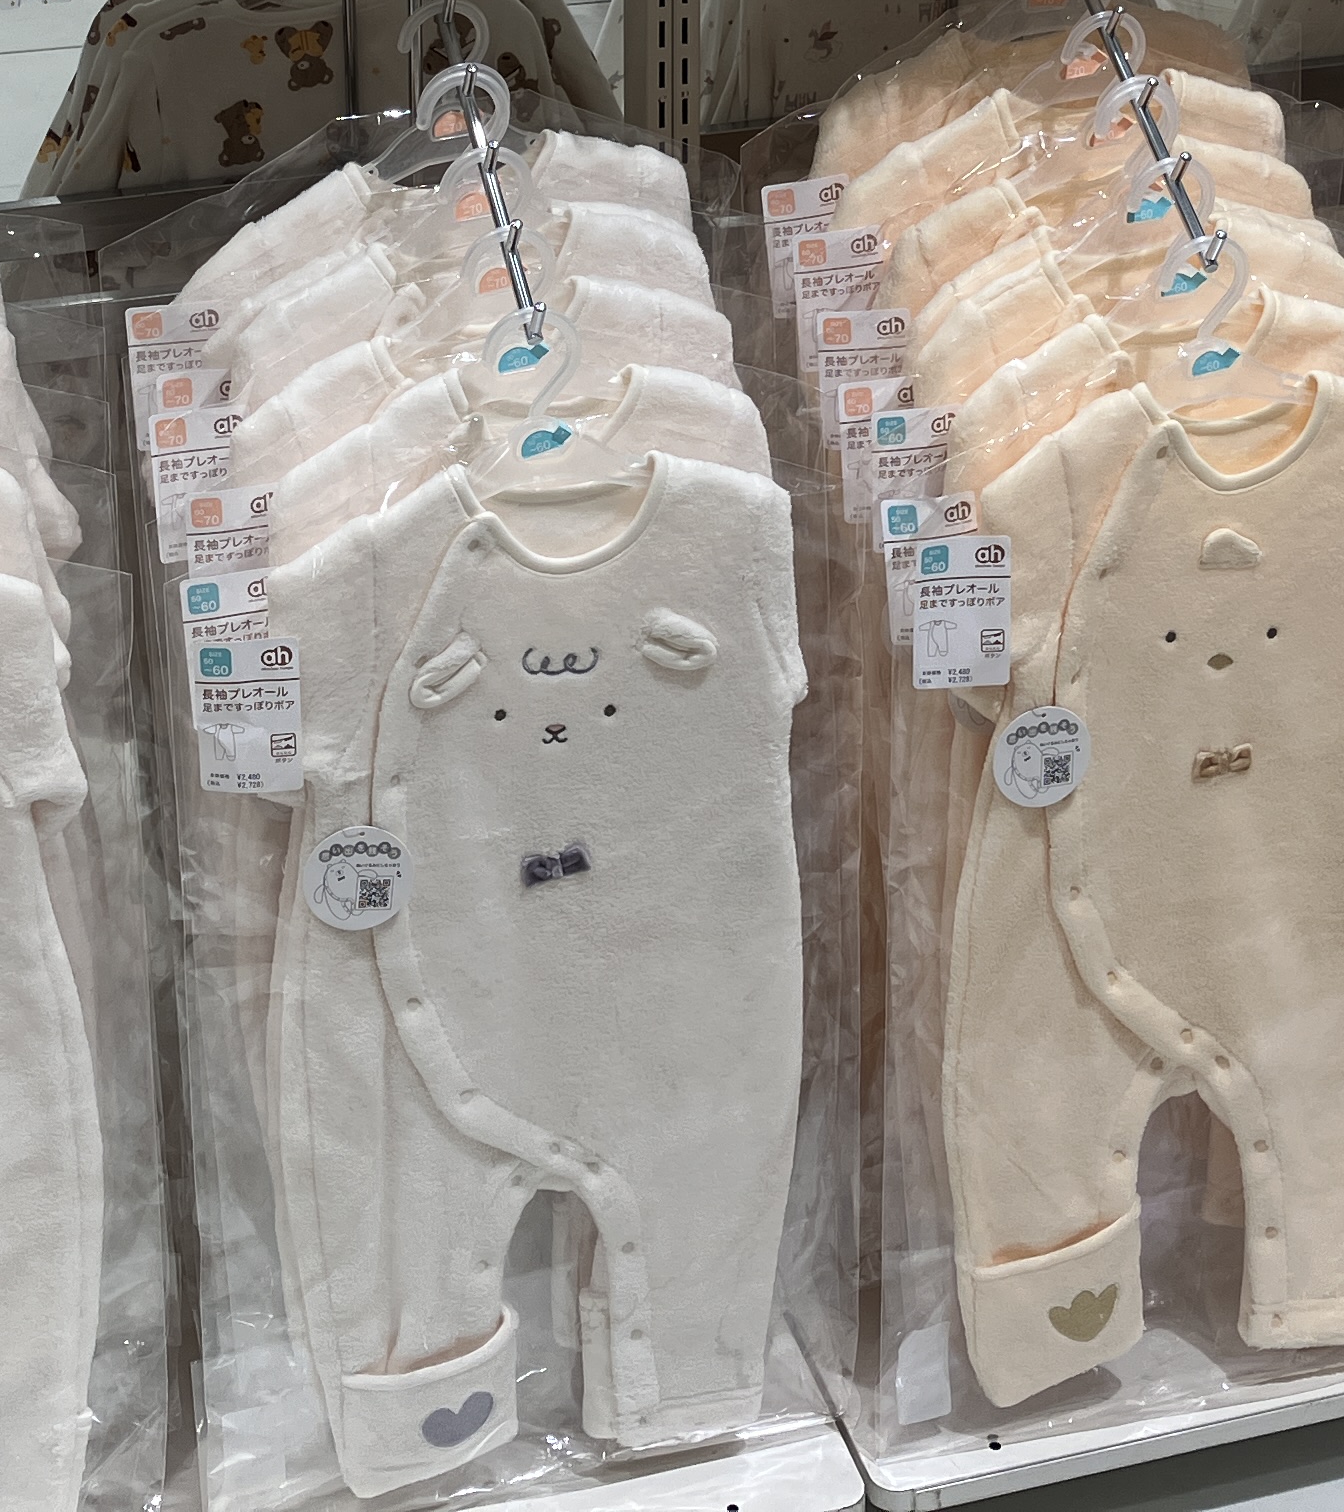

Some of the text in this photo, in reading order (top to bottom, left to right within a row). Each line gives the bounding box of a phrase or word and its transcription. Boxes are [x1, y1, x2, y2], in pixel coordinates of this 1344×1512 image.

[819, 182, 845, 203] ah
[850, 233, 878, 254] ah
[801, 270, 875, 288] 長袖プレオール
[189, 309, 220, 328] ah
[876, 316, 905, 336] ah
[824, 353, 901, 367] 長袖プレオール
[944, 500, 972, 522] ah
[974, 544, 1006, 564] ah
[919, 583, 1000, 598] 長袖プレオール
[919, 596, 1006, 610] 足まですっぽりボア
[260, 645, 293, 667] ah
[202, 686, 289, 701] 長袖プレオール
[202, 700, 295, 713] 足まですっぽりボア
